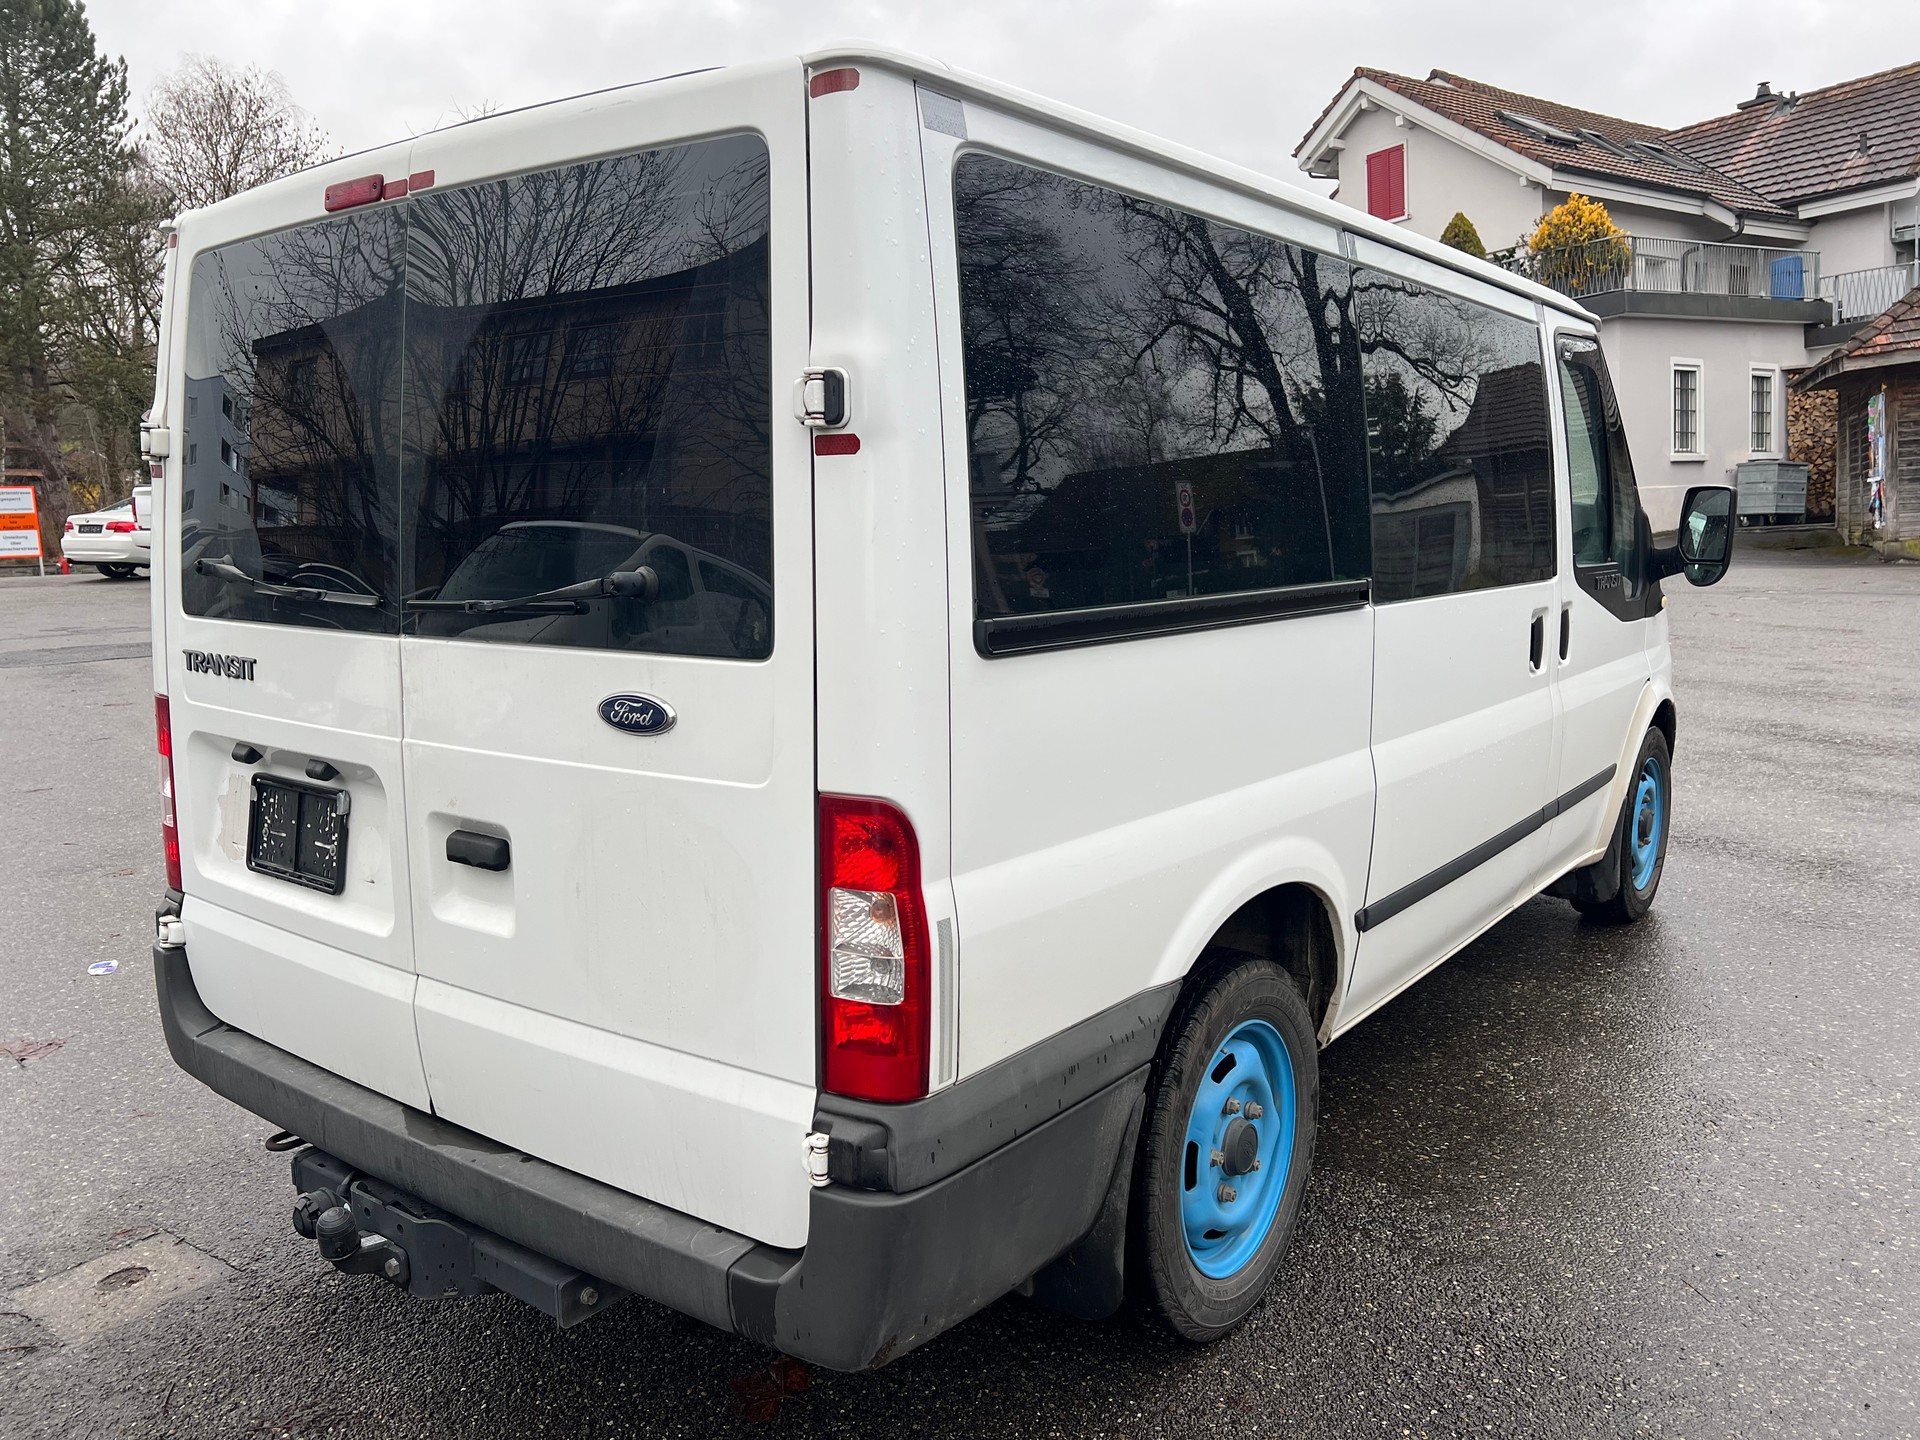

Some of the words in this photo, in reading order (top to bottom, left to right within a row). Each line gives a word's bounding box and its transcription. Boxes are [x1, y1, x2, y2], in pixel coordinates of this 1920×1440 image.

[1595, 573, 1621, 590] TRANSIT
[182, 649, 257, 681] TRANSIT
[610, 699, 654, 726] Ford
